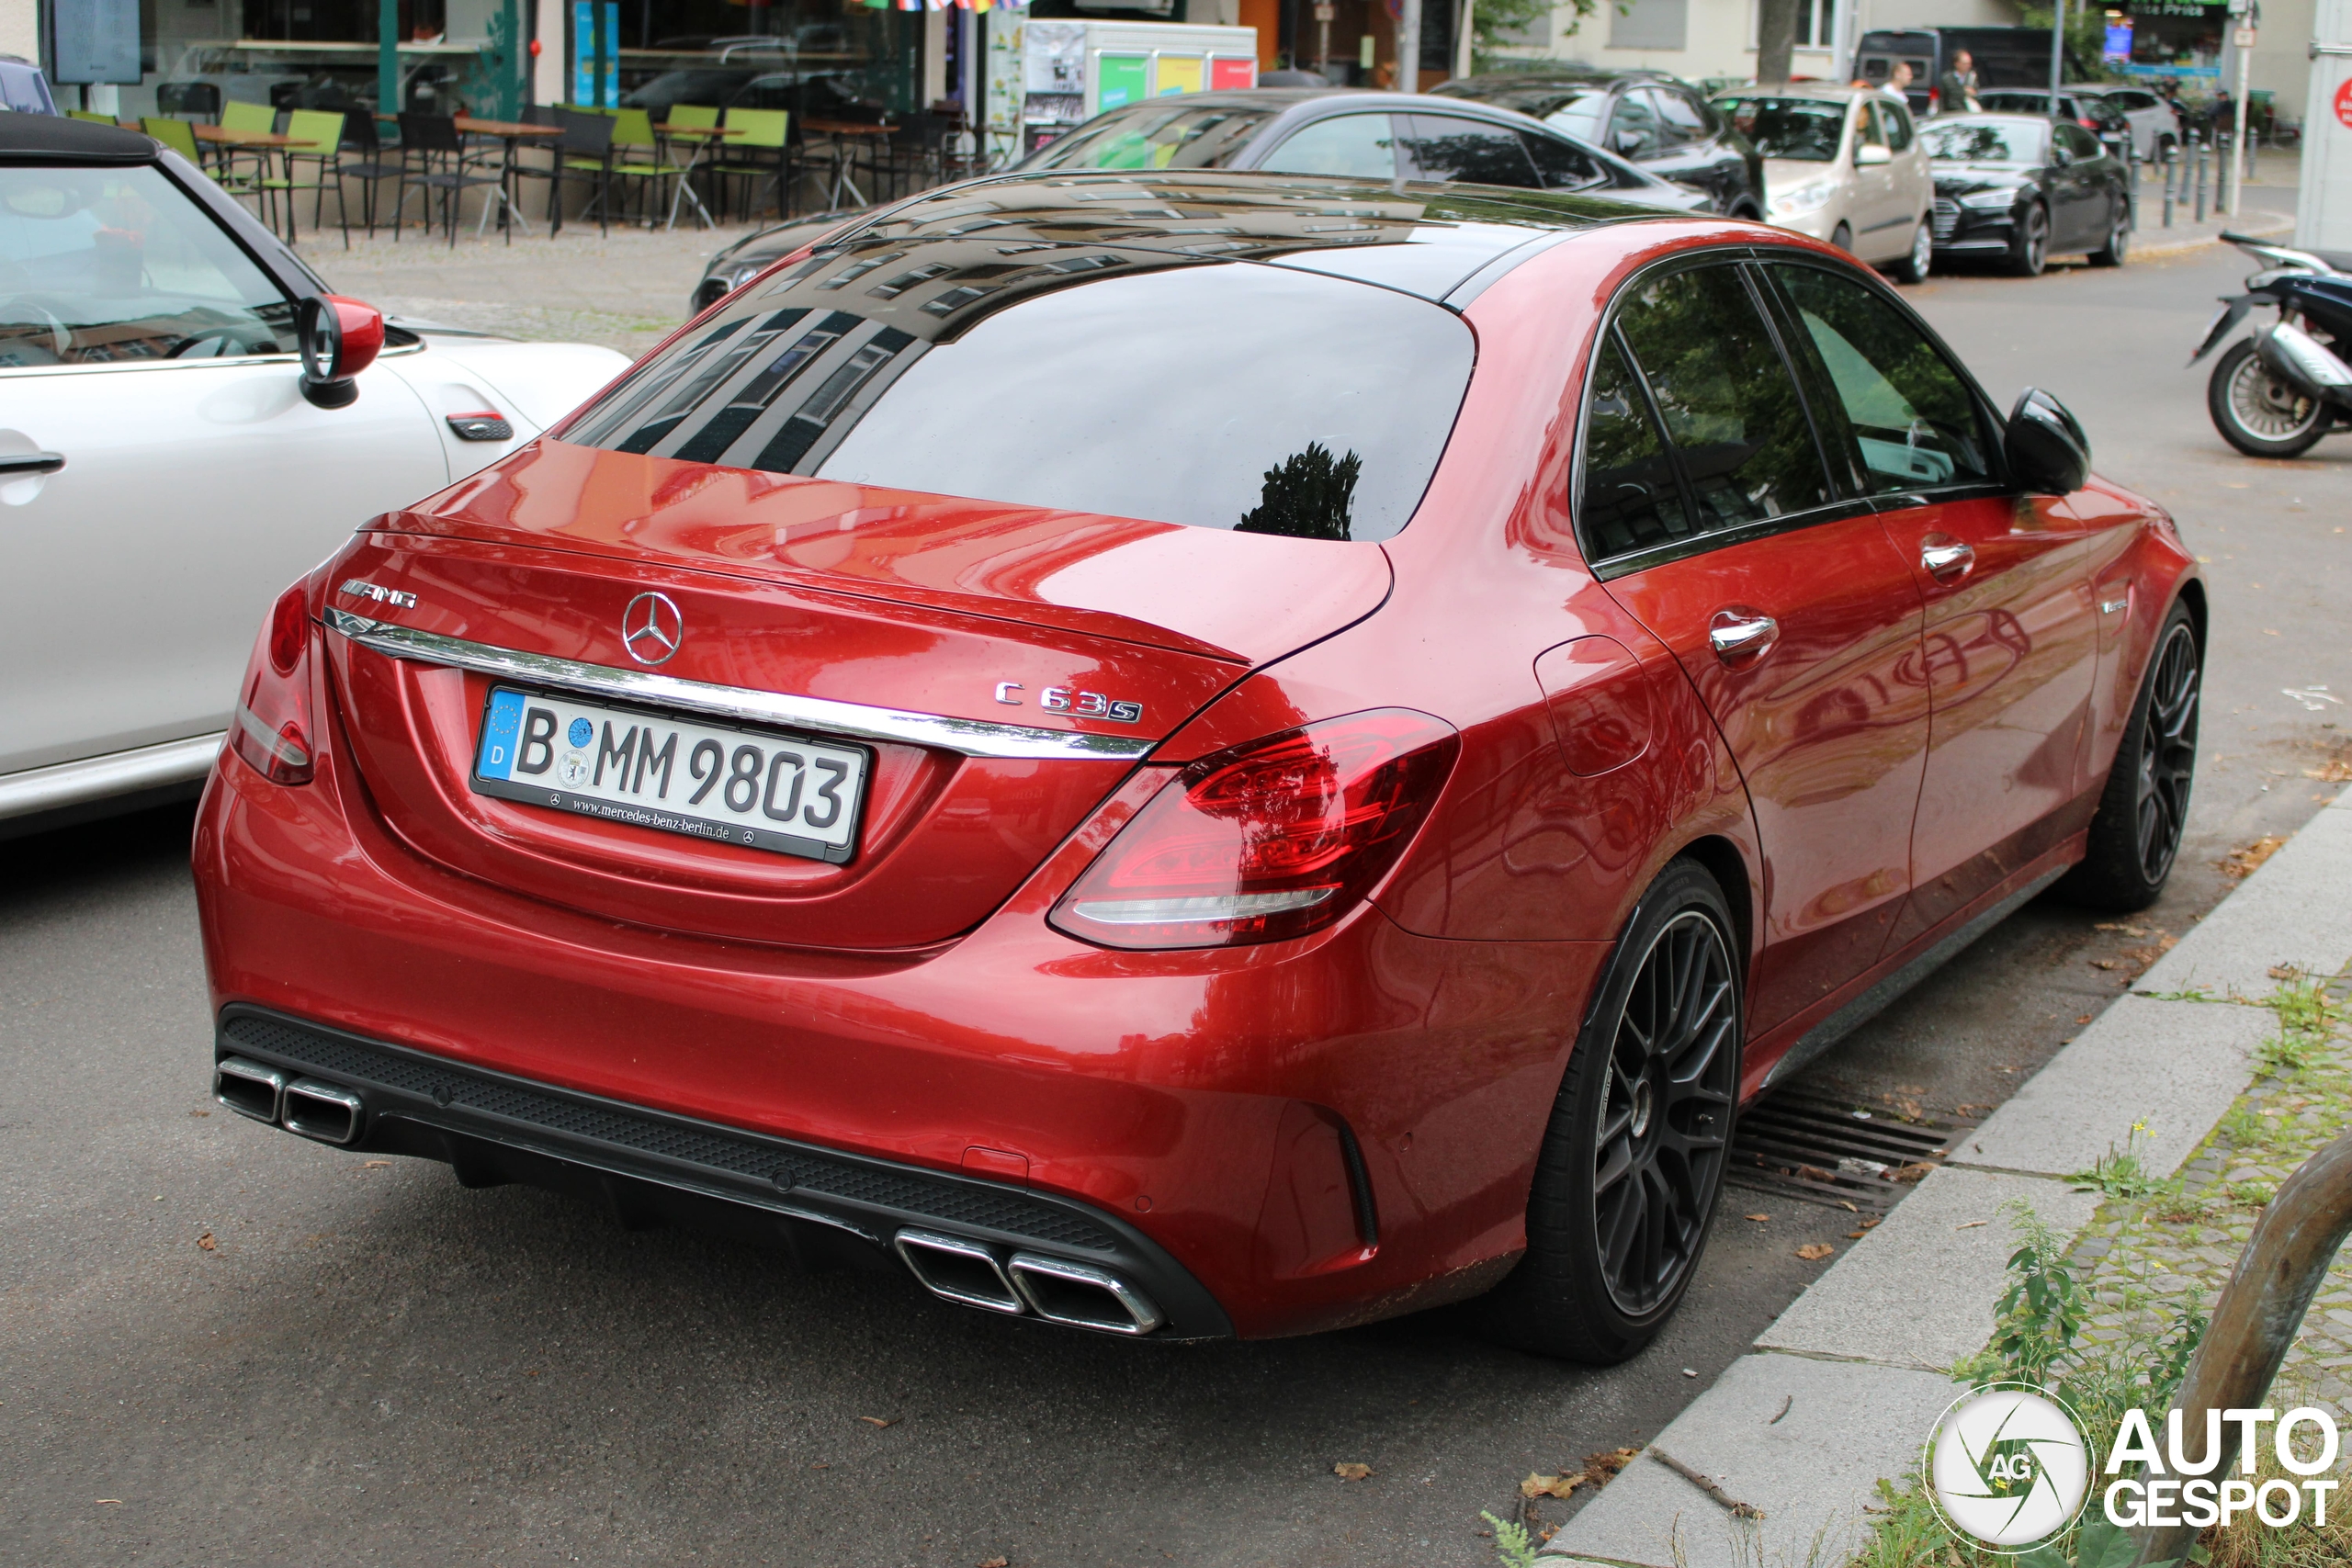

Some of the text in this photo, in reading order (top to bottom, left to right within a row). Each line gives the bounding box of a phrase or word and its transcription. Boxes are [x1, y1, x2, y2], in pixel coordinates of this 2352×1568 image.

[358, 582, 417, 609] AMG
[491, 746, 504, 764] D
[688, 739, 849, 829] 9803
[573, 799, 729, 840] www.mercedes-benz-berlin.de
